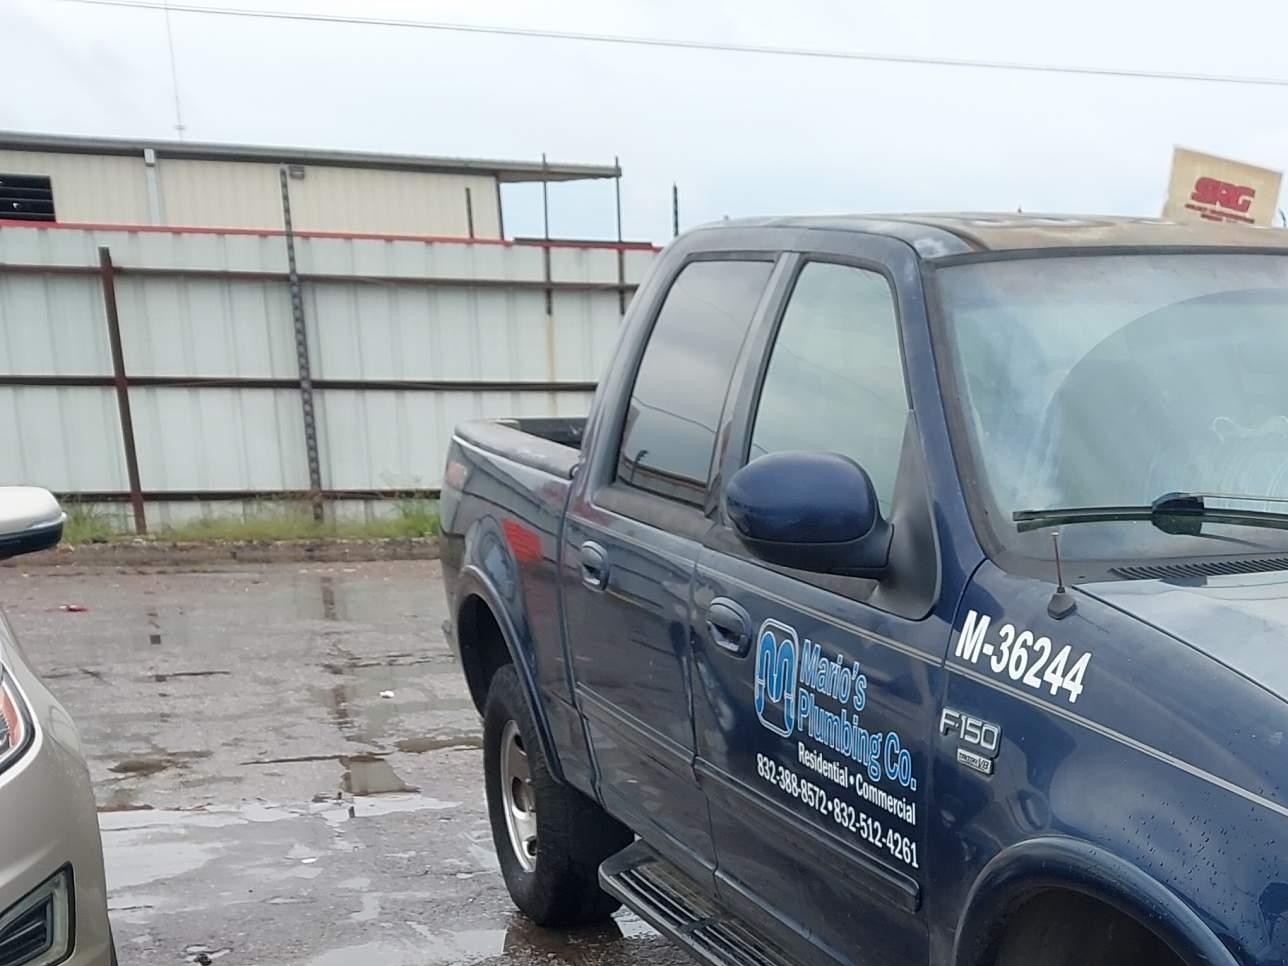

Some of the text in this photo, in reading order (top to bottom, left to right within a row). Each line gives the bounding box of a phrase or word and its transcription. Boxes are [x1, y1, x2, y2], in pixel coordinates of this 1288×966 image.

[799, 639, 868, 711] Mario's
[954, 609, 1092, 702] M-36244
[797, 687, 917, 791] Plumbing Co.
[797, 741, 916, 825] Residential Commercial
